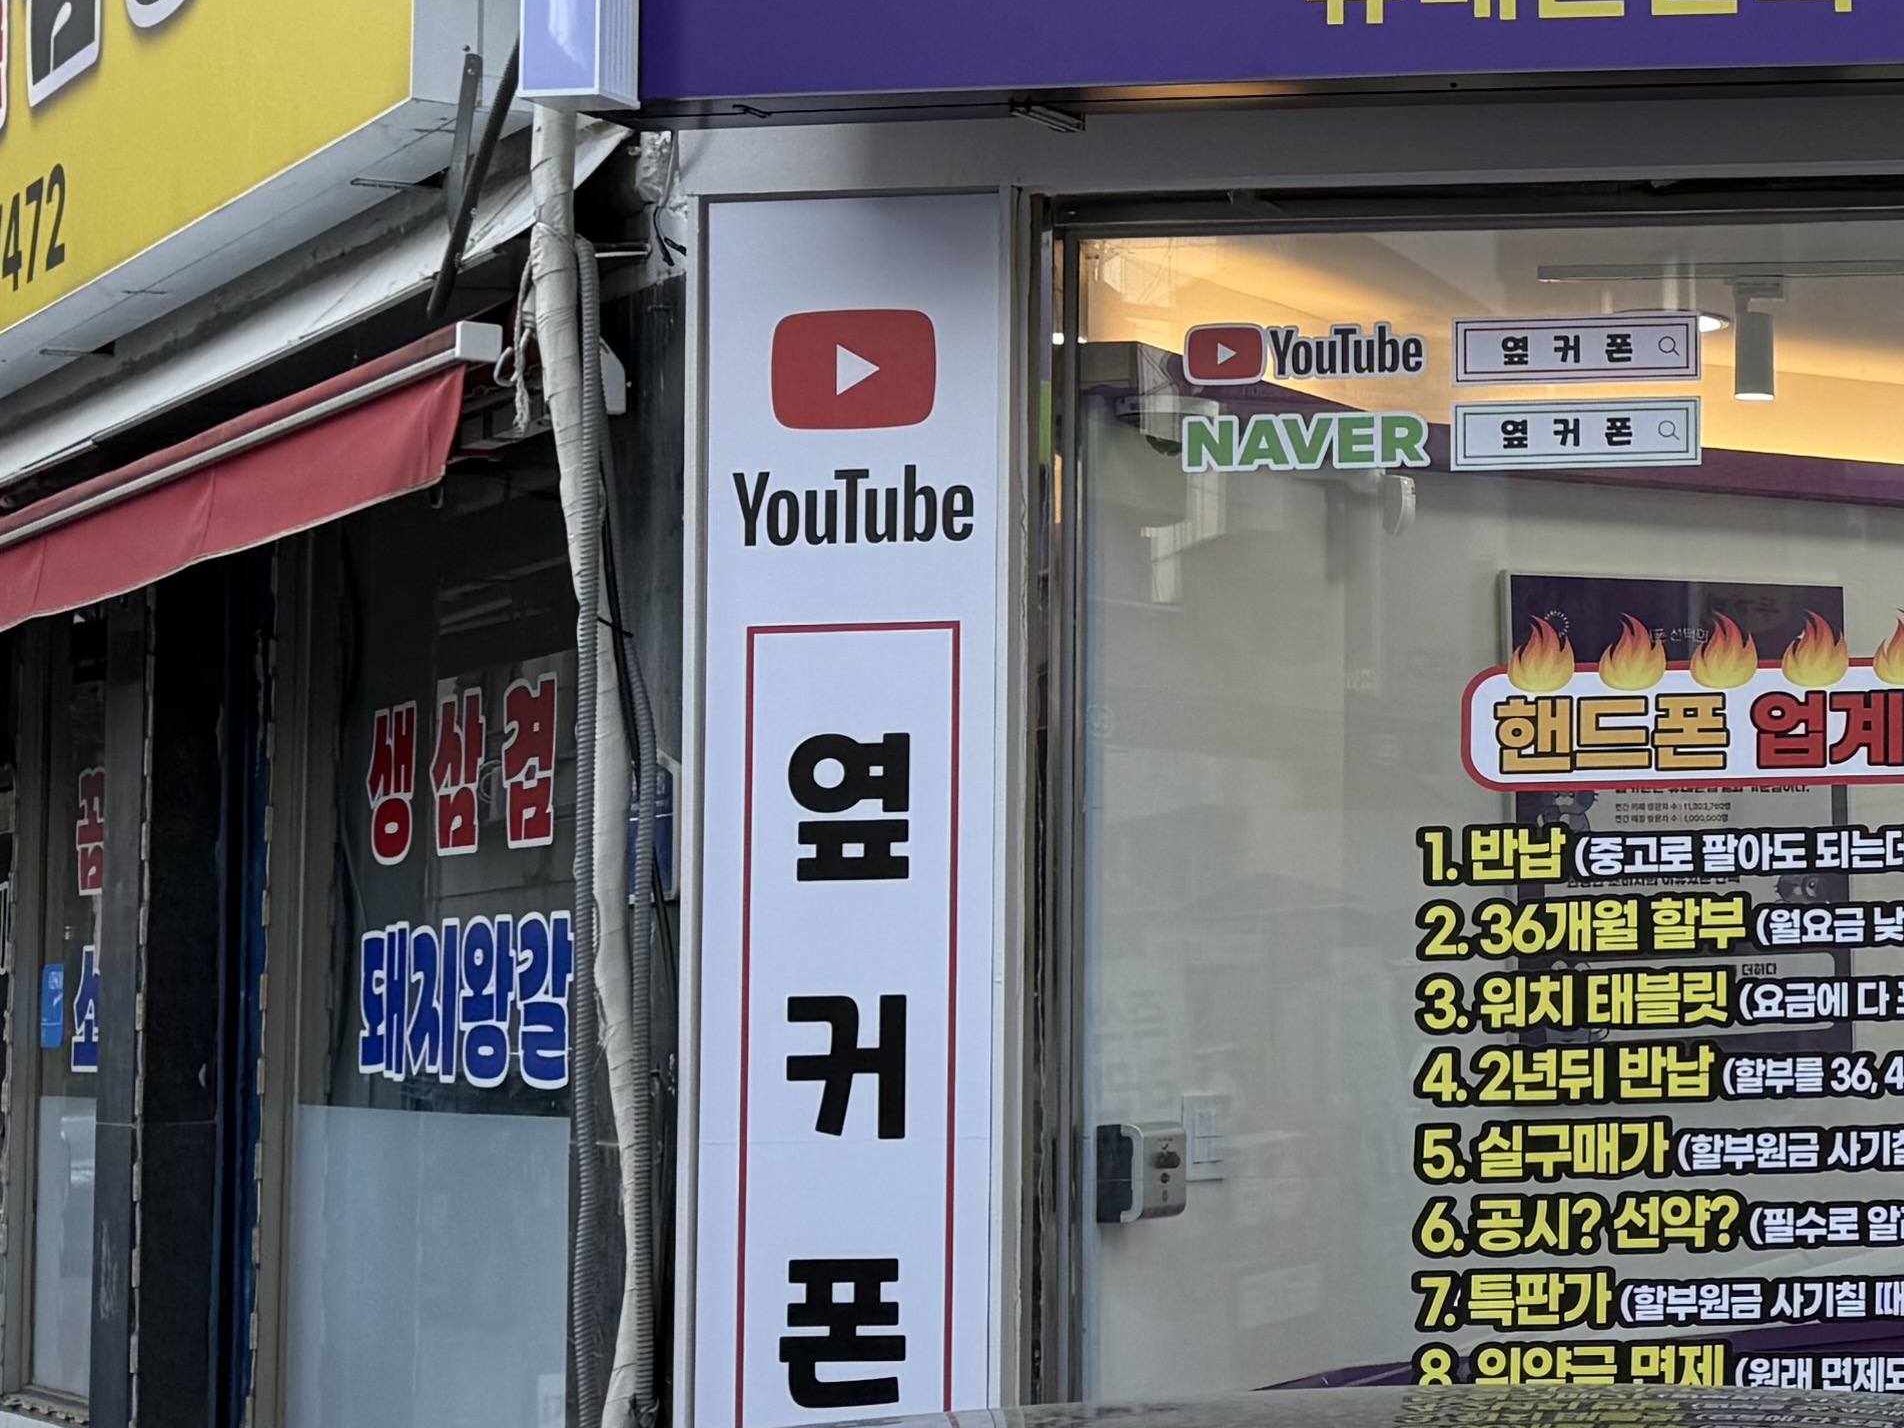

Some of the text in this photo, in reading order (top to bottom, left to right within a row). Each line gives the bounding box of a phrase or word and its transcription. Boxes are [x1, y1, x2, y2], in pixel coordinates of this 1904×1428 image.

[1270, 328, 1423, 376] YouTube
[1186, 416, 1426, 468] NAVER
[732, 467, 974, 547] YouTube
[1494, 693, 1730, 774] 핸드폰
[1751, 689, 1904, 768] 업계
[1424, 830, 1459, 881] 1.
[1471, 826, 1566, 880] 반납
[1575, 833, 1691, 877] (중고로
[1701, 832, 1805, 873] 팔아도
[1424, 906, 1470, 957] 2.
[1480, 901, 1639, 955] 36개월
[1651, 897, 1746, 948] 할부
[1756, 906, 1865, 948] (월요금
[359, 910, 574, 1089] 돼지왕갈
[1424, 981, 1469, 1030] 3.
[1480, 978, 1575, 1029] 워치
[1587, 974, 1729, 1025] 태블릿
[1739, 980, 1846, 1023] (요금에
[1857, 981, 1891, 1018] 다
[778, 730, 911, 1409] 옆커폰
[1424, 1203, 1464, 1253] 6.
[1476, 1199, 1599, 1252] 공시?
[1613, 1195, 1740, 1248] 선약?
[1750, 1205, 1858, 1245] (필수로
